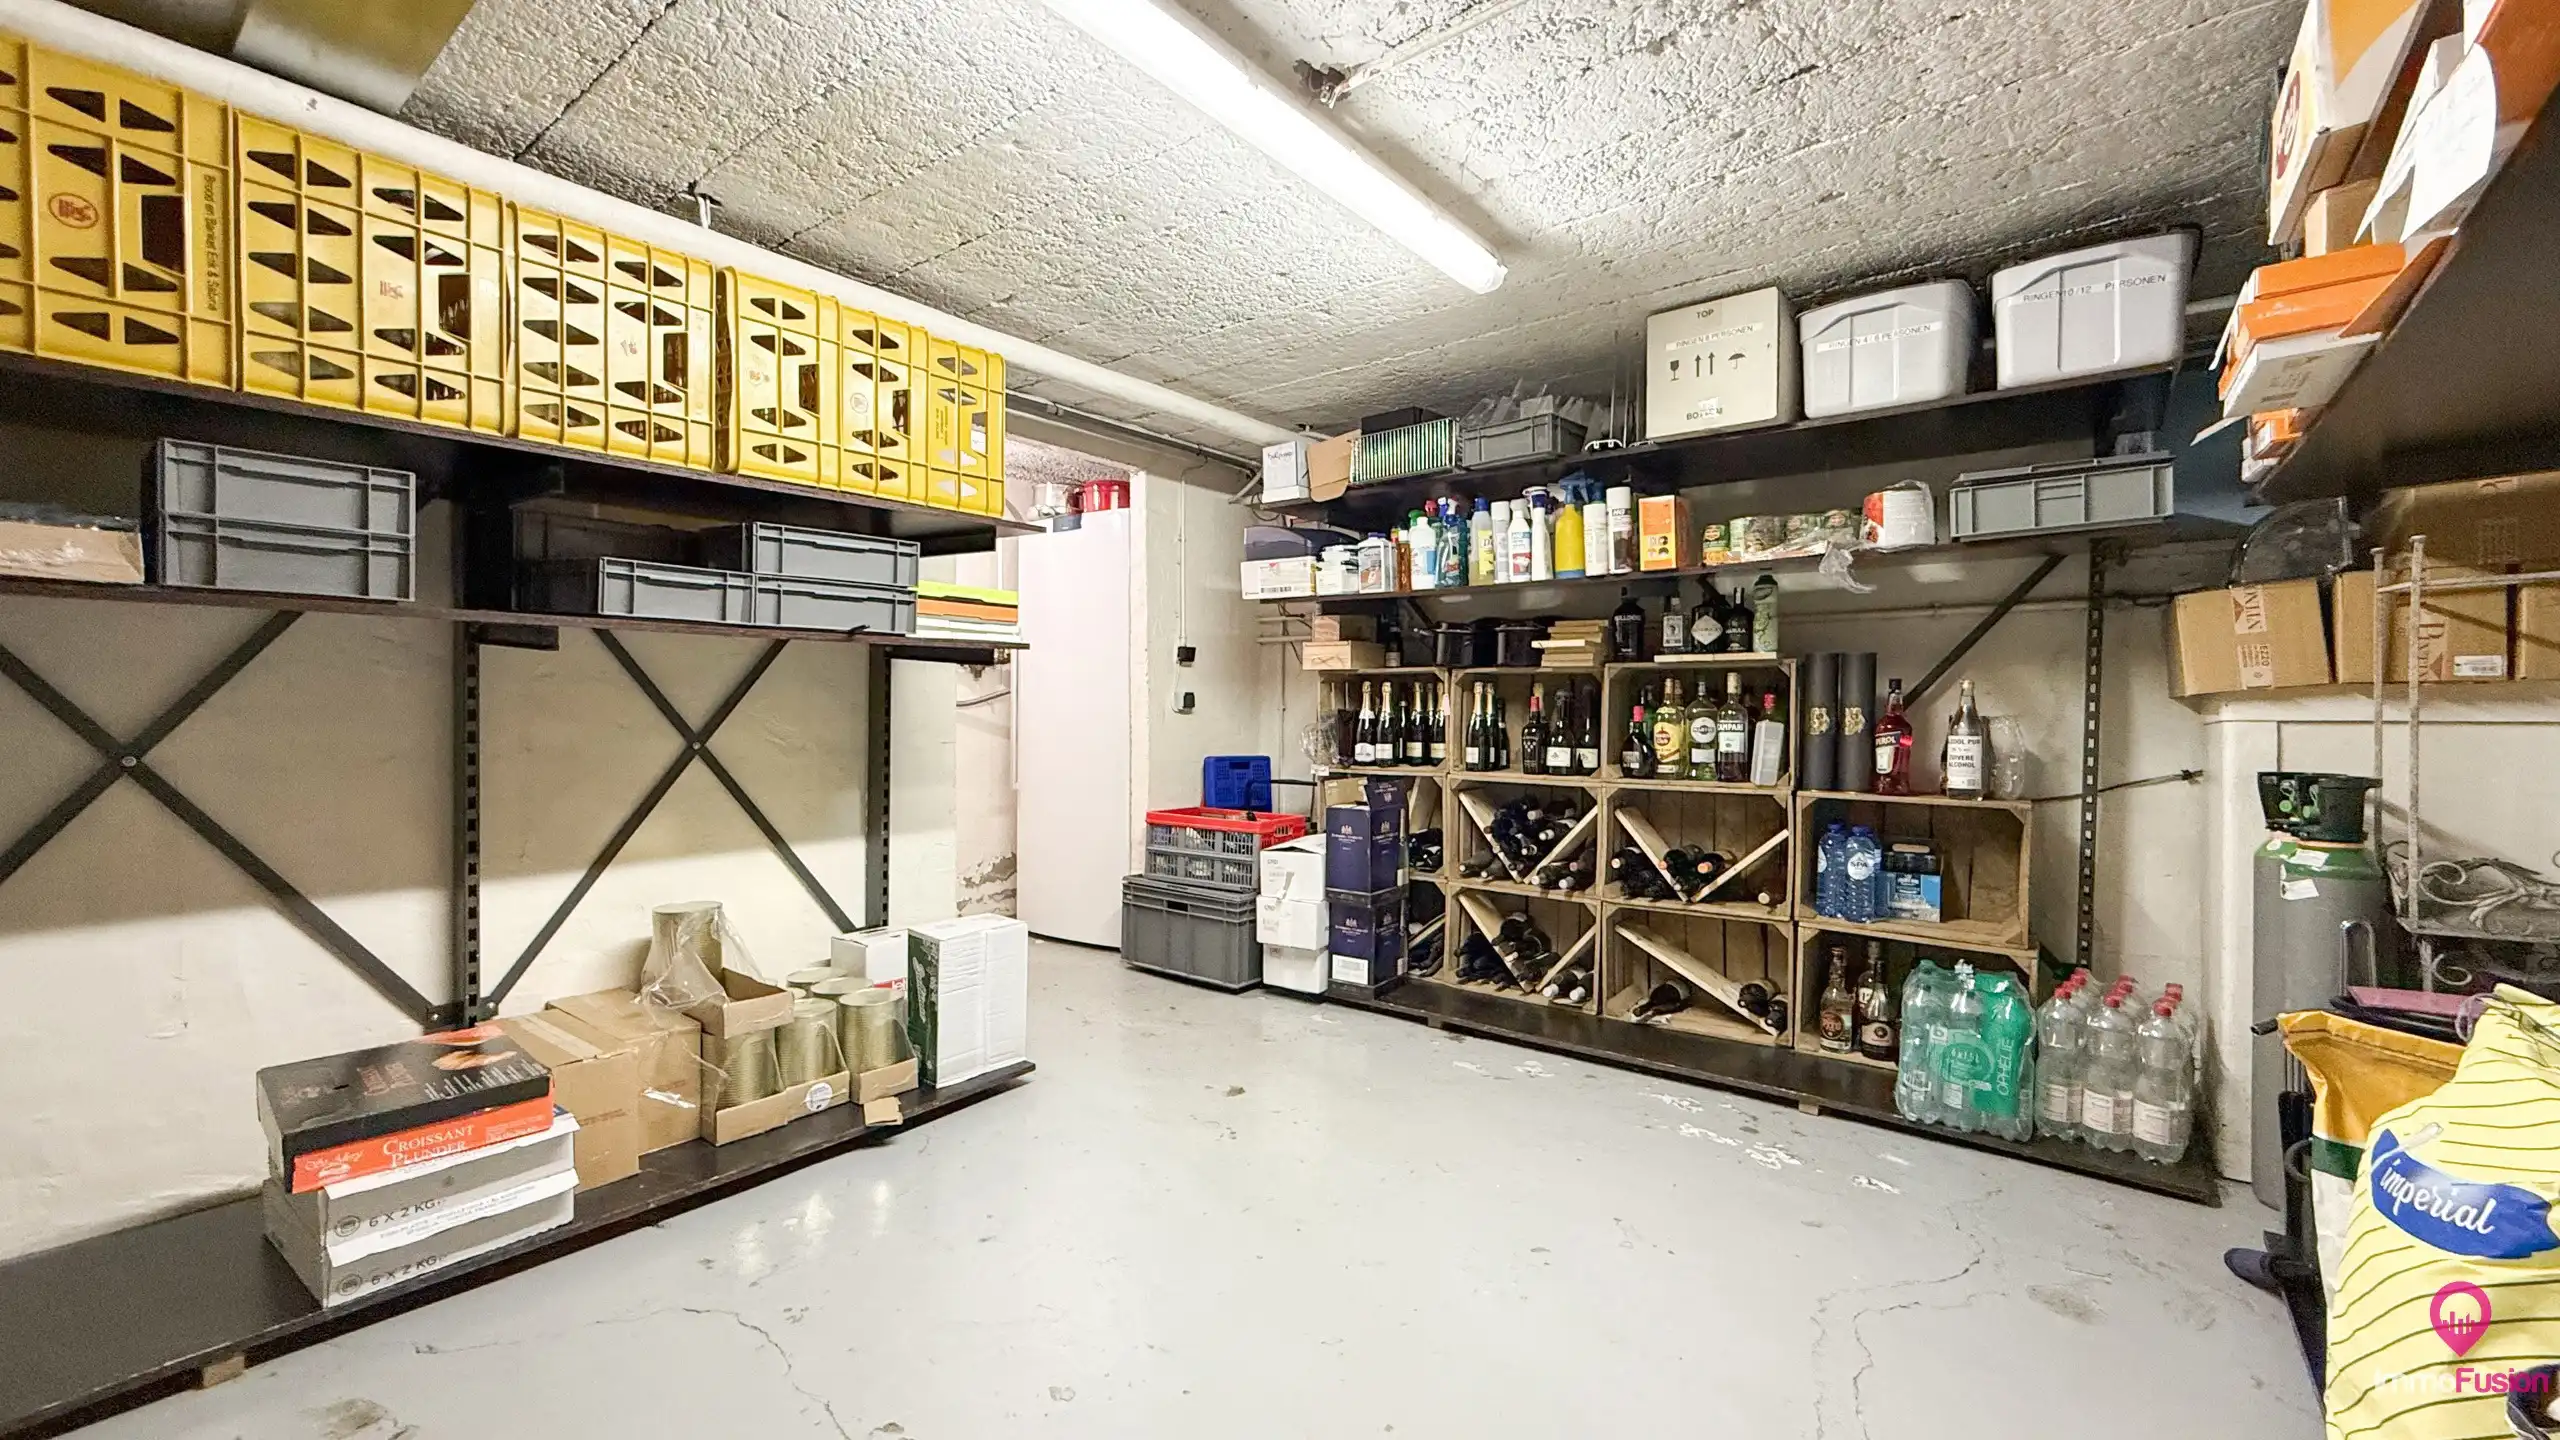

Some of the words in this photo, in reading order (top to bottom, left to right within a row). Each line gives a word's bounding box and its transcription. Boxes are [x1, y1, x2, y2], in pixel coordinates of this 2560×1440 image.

[1696, 308, 1715, 319] TOP
[383, 1124, 475, 1155] CROISSANT
[391, 1140, 467, 1169] PLUNDER
[2379, 1158, 2497, 1235] imperial
[368, 1216, 379, 1228] 6
[400, 1207, 410, 1218] 2
[371, 1274, 380, 1286] 6
[402, 1265, 413, 1275] 2
